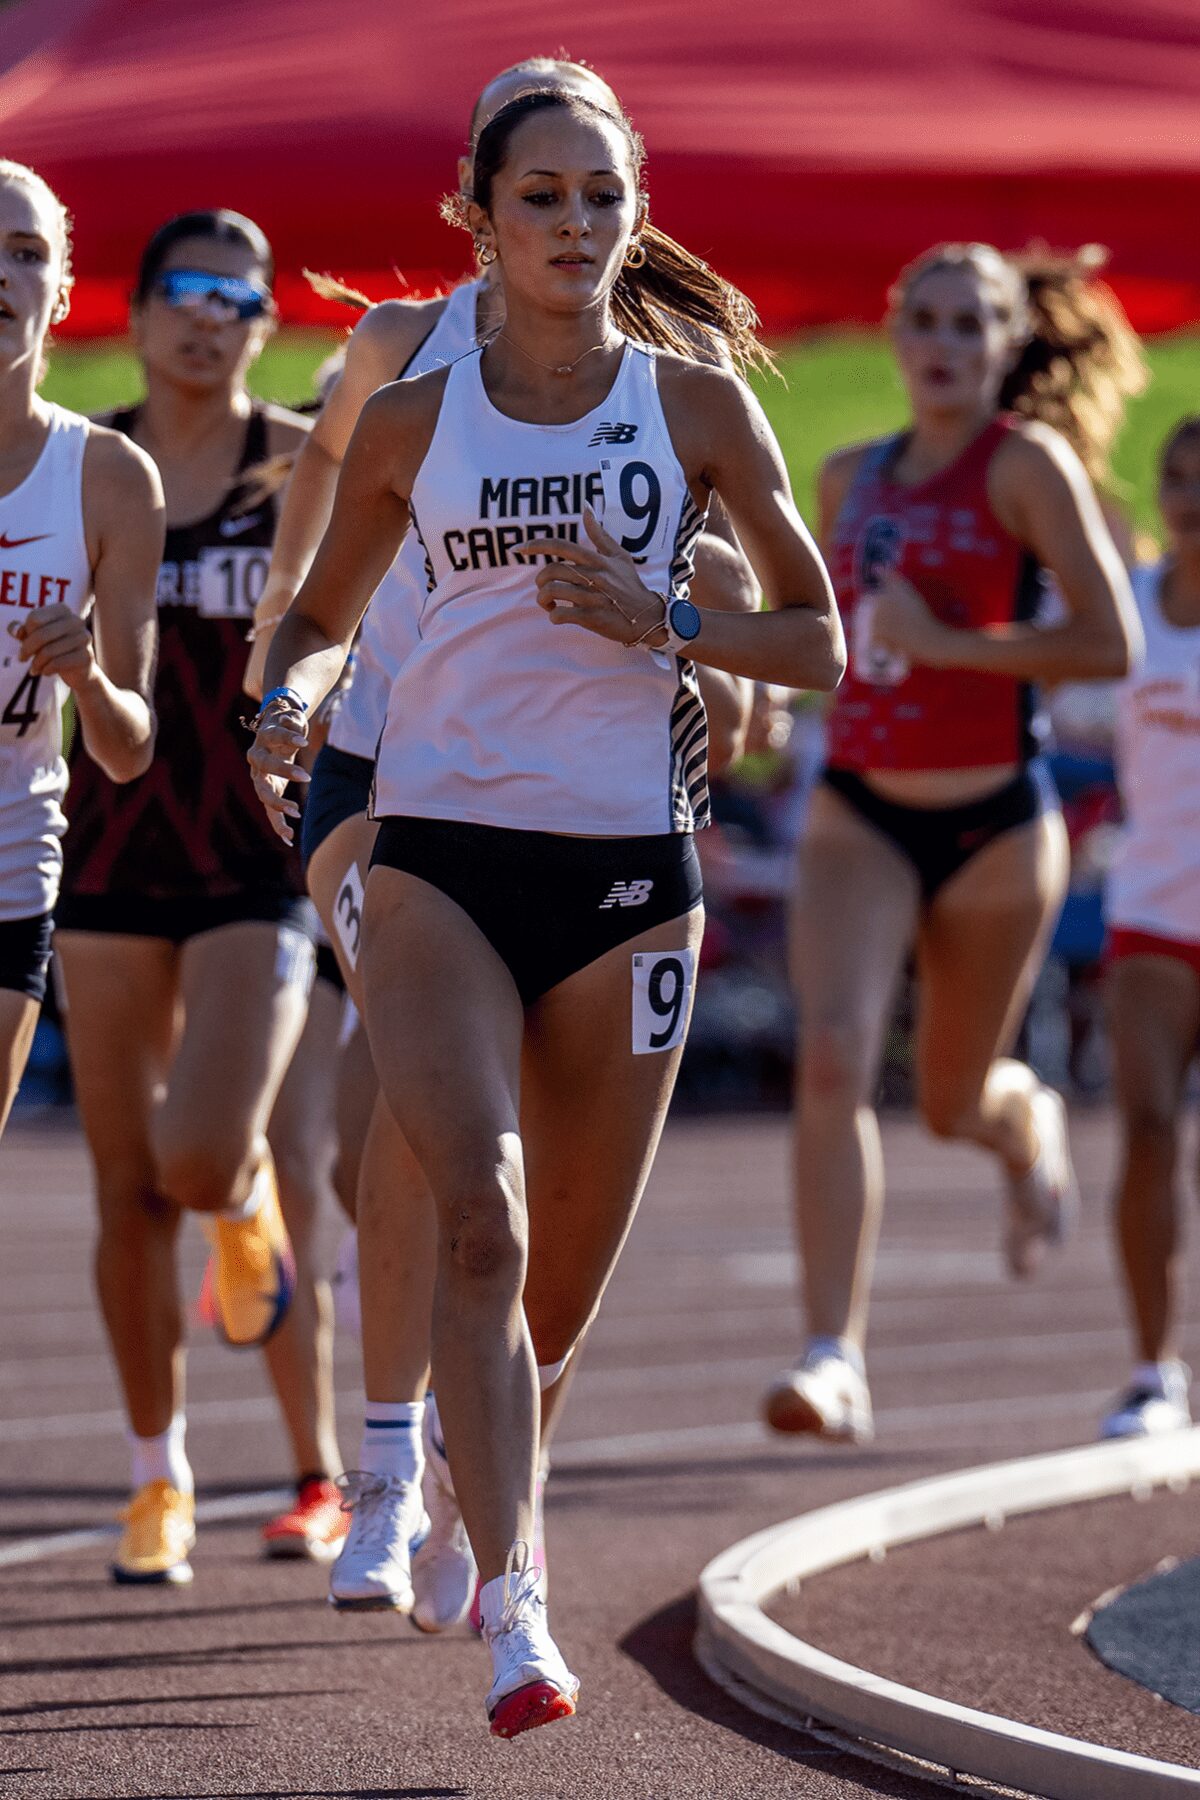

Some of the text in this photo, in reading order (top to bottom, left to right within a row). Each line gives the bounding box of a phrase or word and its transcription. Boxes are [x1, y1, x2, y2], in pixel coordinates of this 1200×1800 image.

[619, 460, 662, 554] 9
[219, 558, 270, 609] 10
[1, 666, 42, 738] 4
[338, 883, 361, 954] 3
[648, 957, 685, 1048] 9
